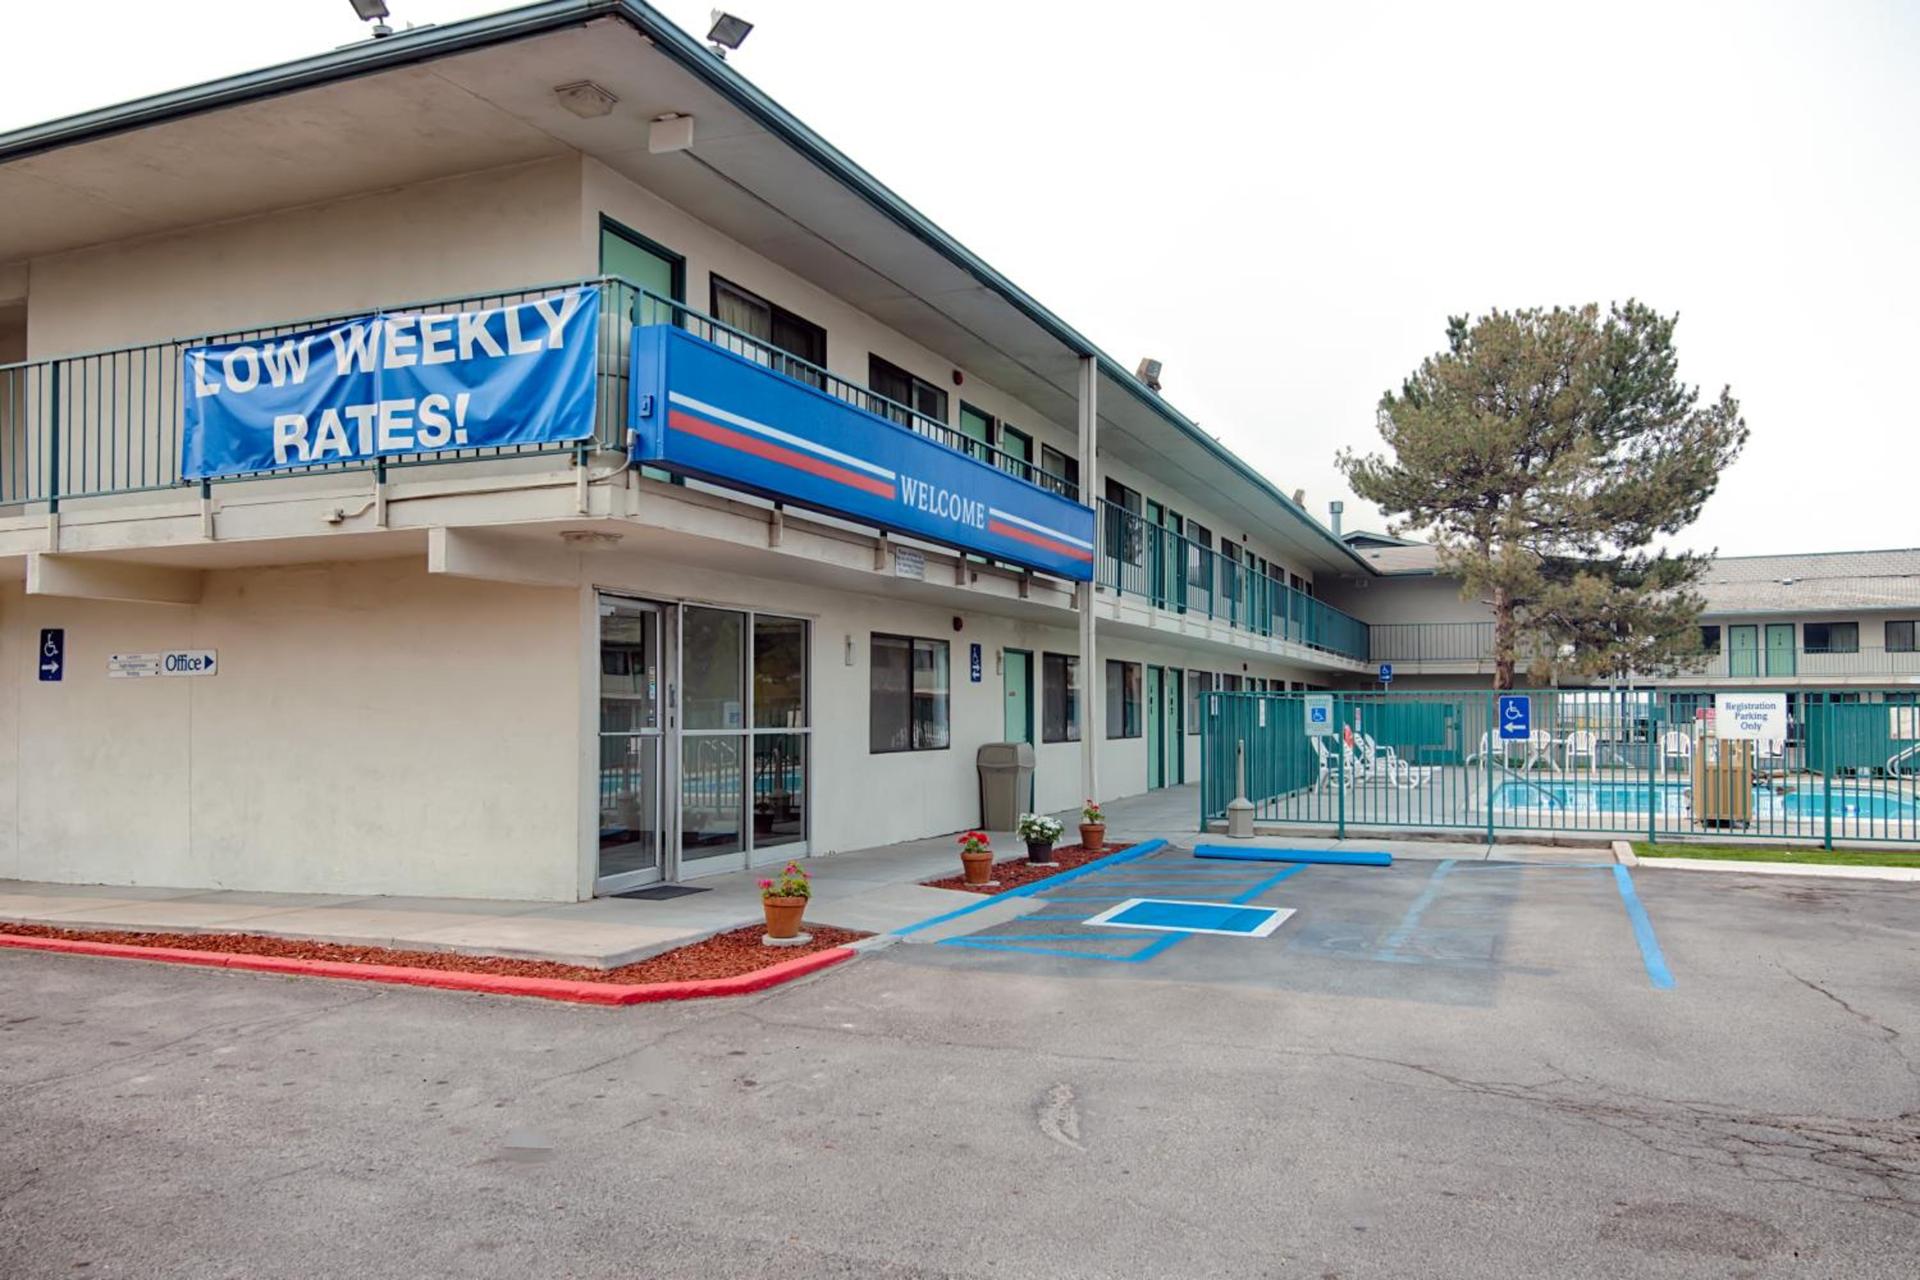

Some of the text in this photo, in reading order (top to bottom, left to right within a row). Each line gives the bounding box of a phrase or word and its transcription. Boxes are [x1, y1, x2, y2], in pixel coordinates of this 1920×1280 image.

[194, 292, 583, 398] LOW WEEKLY
[273, 393, 471, 464] RATES!
[900, 474, 985, 529] WELCOME
[165, 654, 202, 671] Office
[1725, 702, 1776, 712] Registration
[1735, 712, 1768, 721] Parking
[1740, 721, 1762, 732] Only
